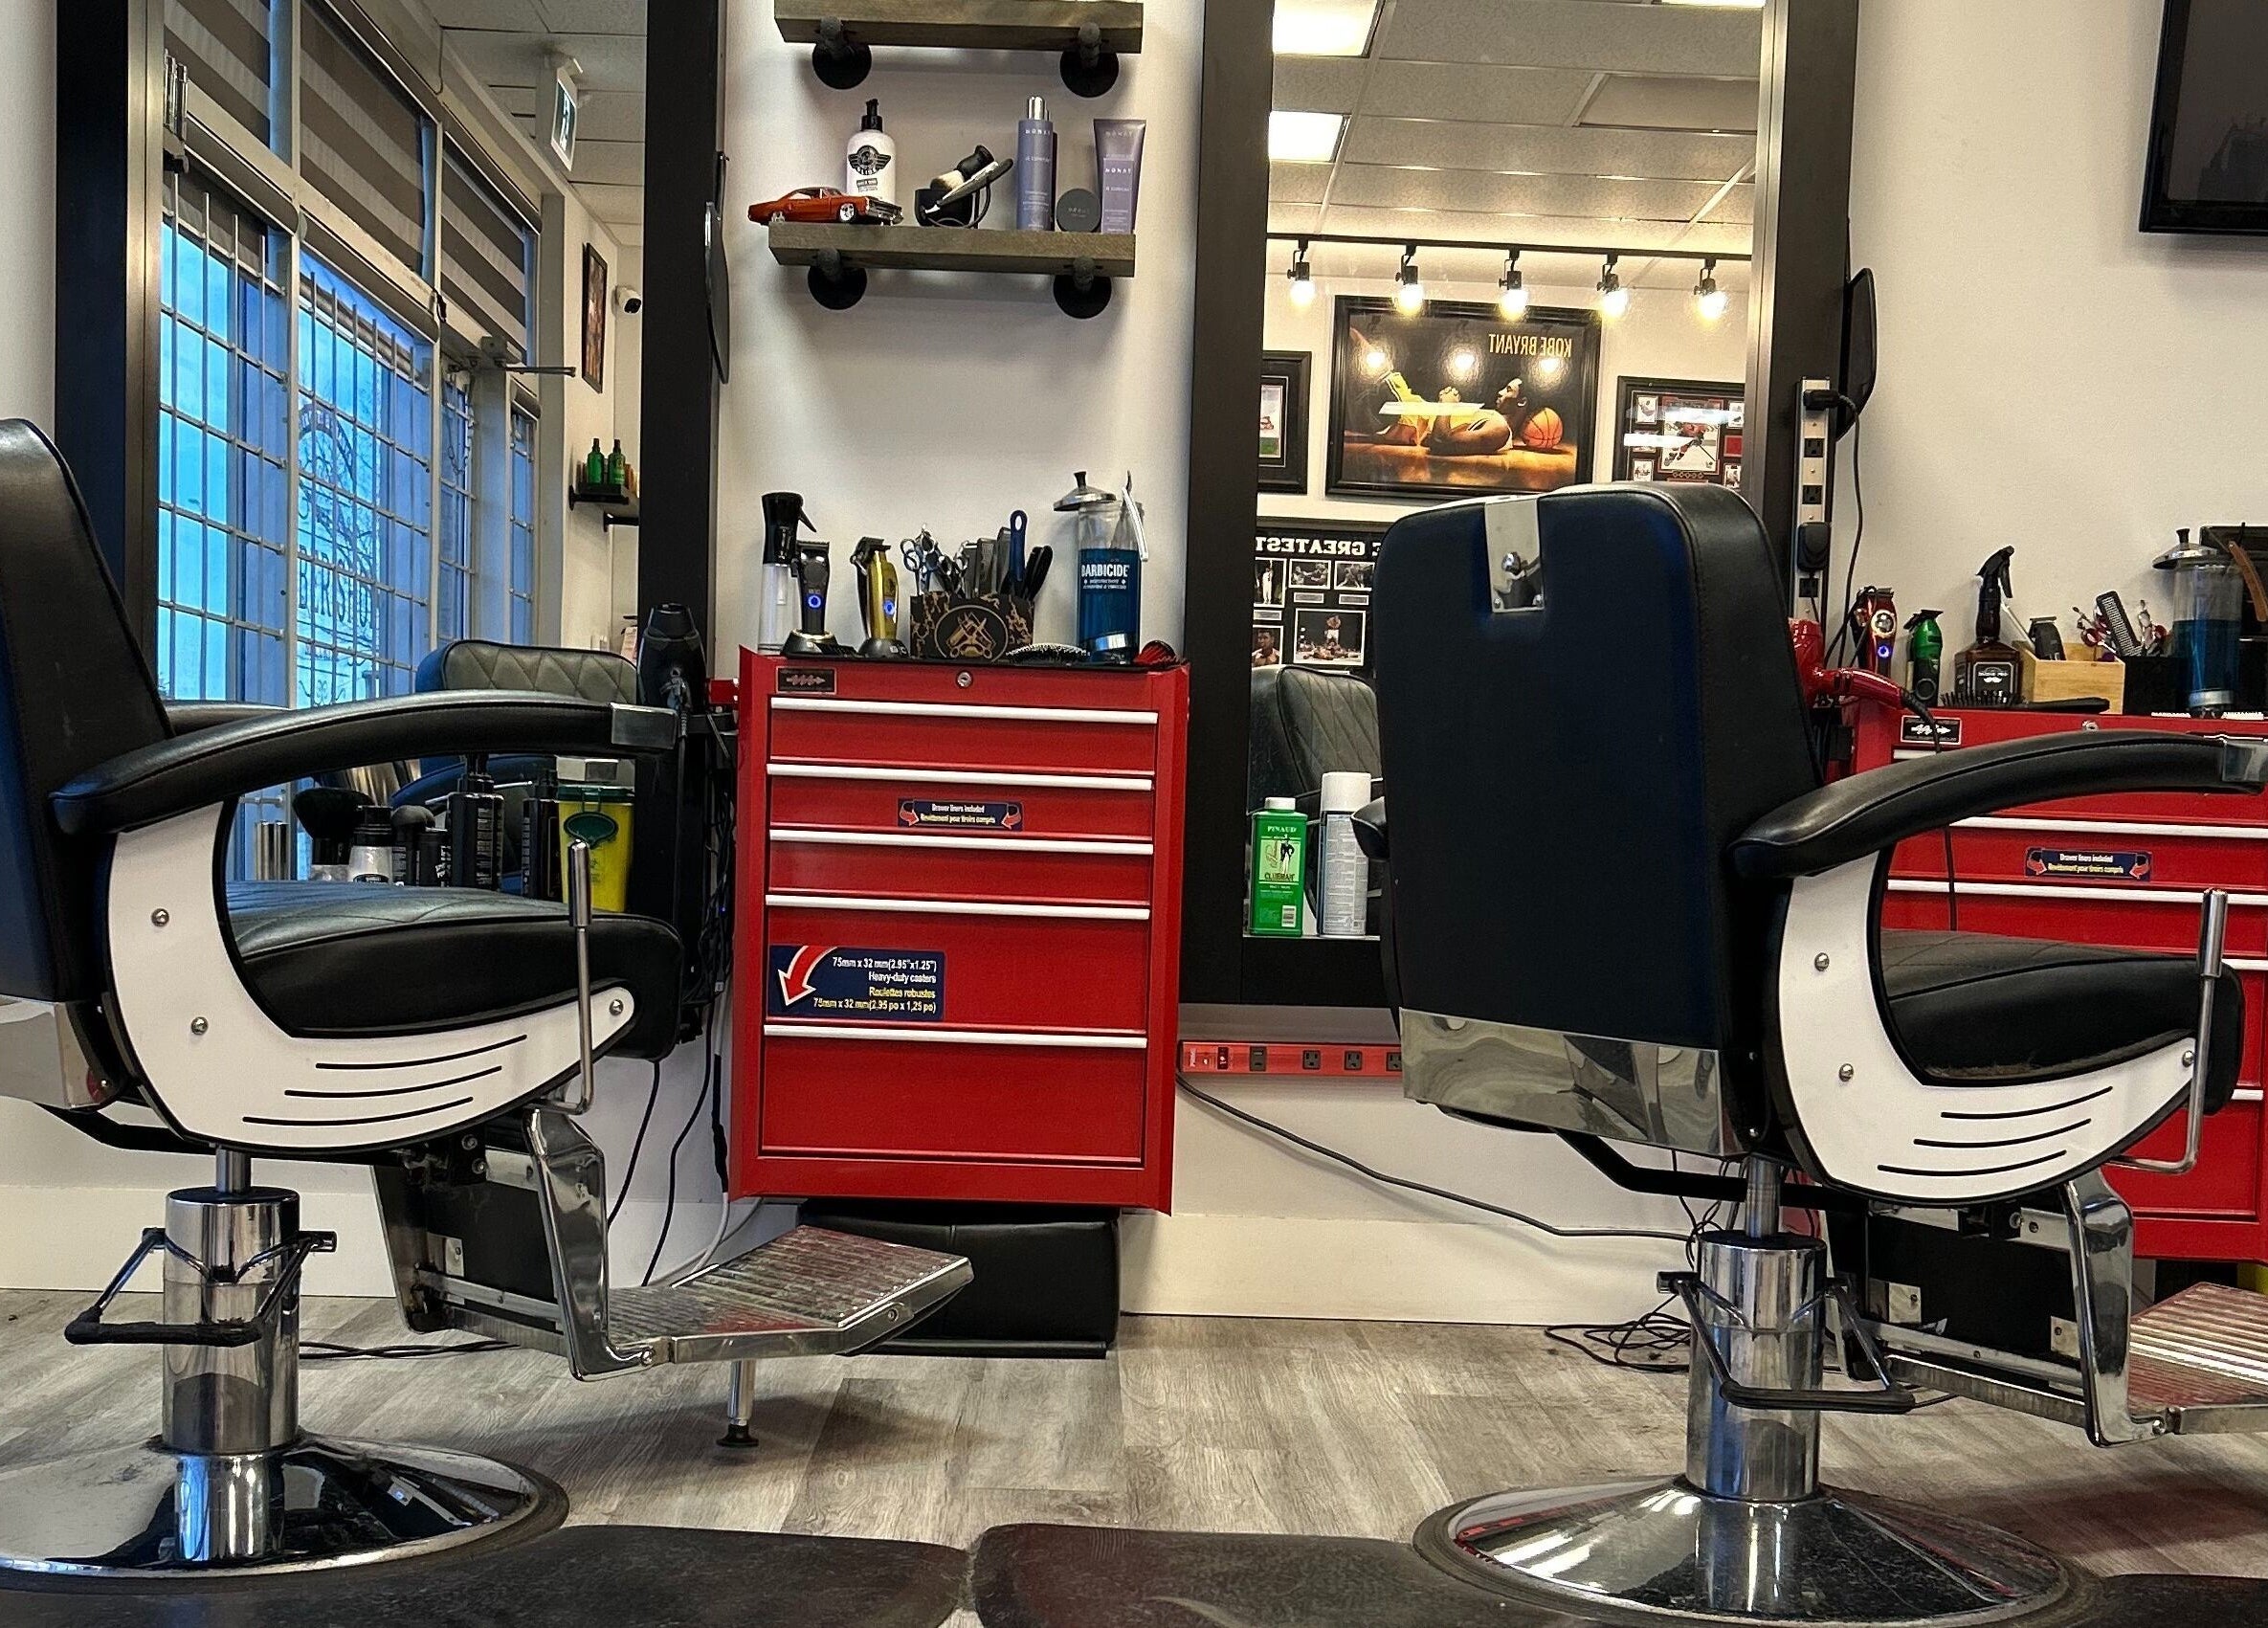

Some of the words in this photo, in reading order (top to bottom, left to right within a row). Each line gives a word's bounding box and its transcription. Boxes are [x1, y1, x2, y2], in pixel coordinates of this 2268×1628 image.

[1081, 564, 1129, 577] BARBICIDE
[833, 956, 856, 968] 75mm
[863, 958, 874, 969] 32
[868, 971, 910, 984] Heavy-duty
[844, 998, 855, 1009] 32
[888, 1002, 900, 1012] po
[923, 1002, 937, 1015] po)
